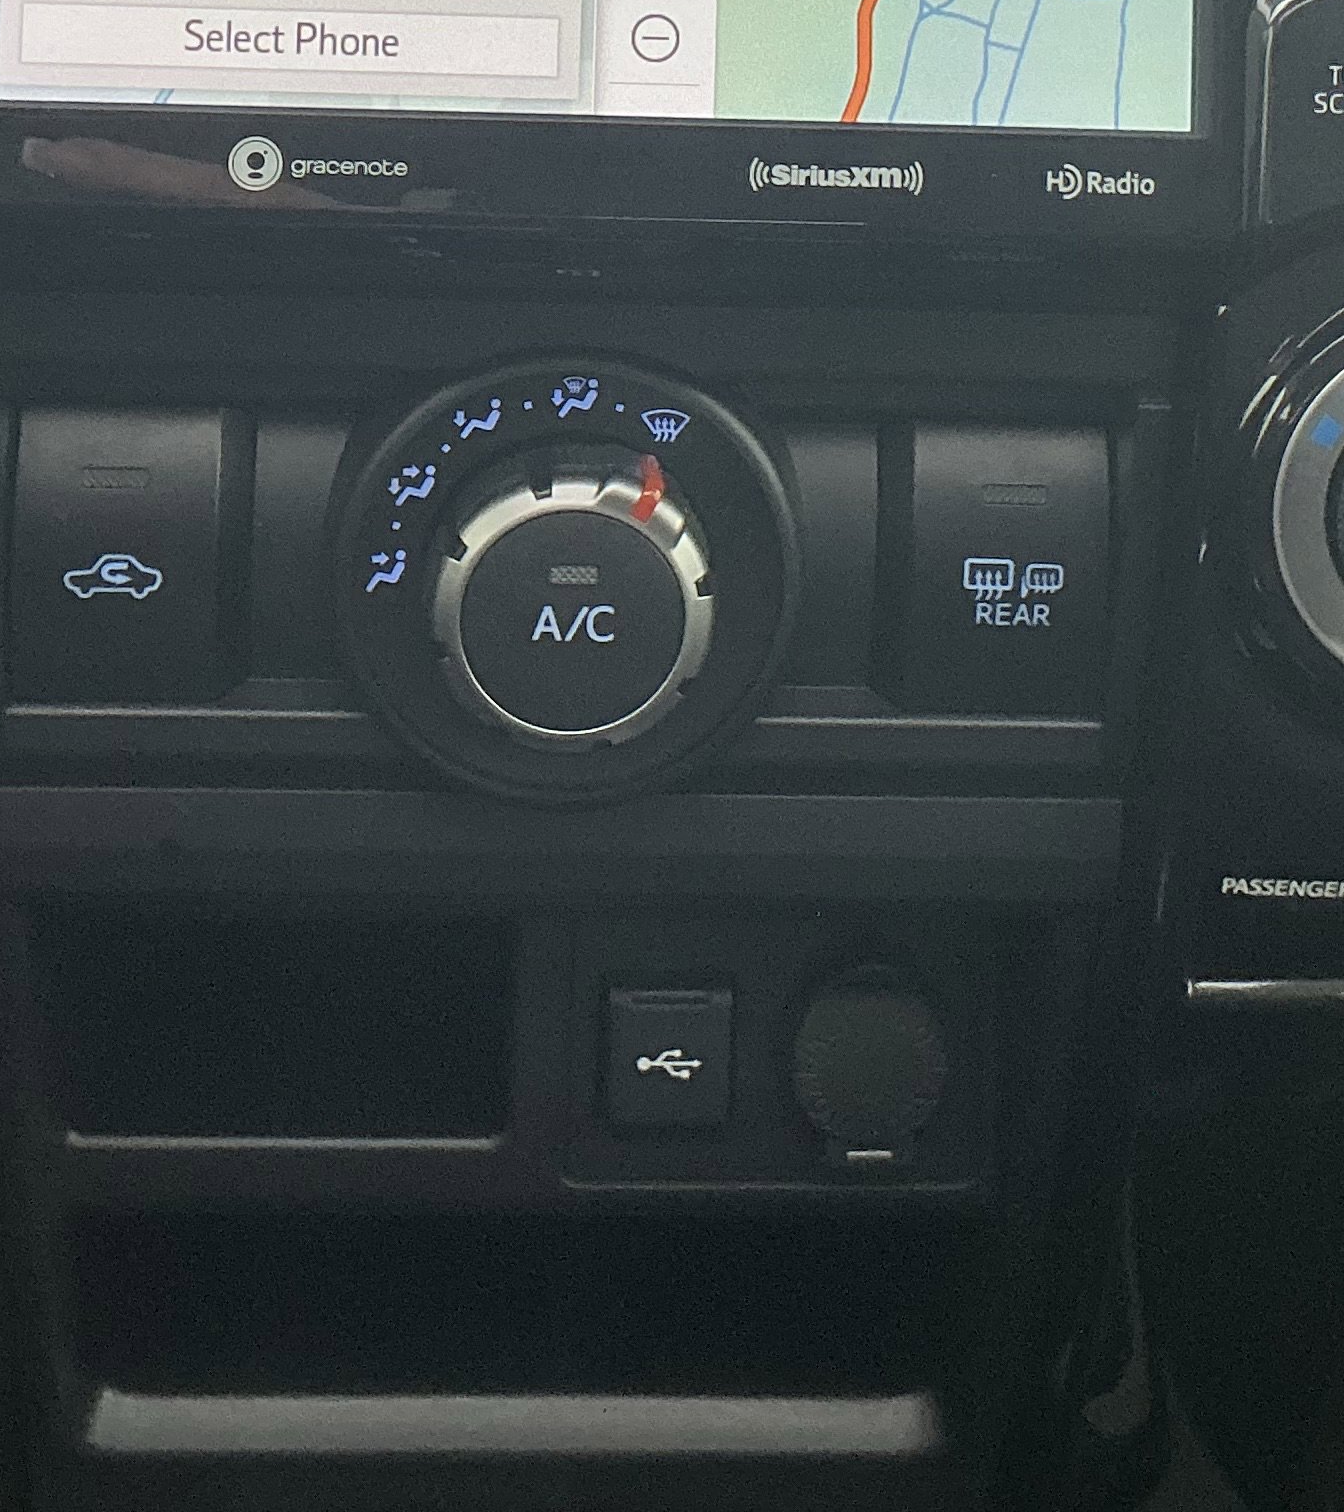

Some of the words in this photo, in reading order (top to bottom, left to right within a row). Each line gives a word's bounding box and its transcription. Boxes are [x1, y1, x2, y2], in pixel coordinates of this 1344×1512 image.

[183, 19, 286, 55] Select
[295, 22, 401, 58] Phone
[290, 155, 409, 180] gracenote
[1086, 169, 1156, 196] Radio
[530, 604, 616, 643] A/C
[975, 601, 1051, 627] REAR
